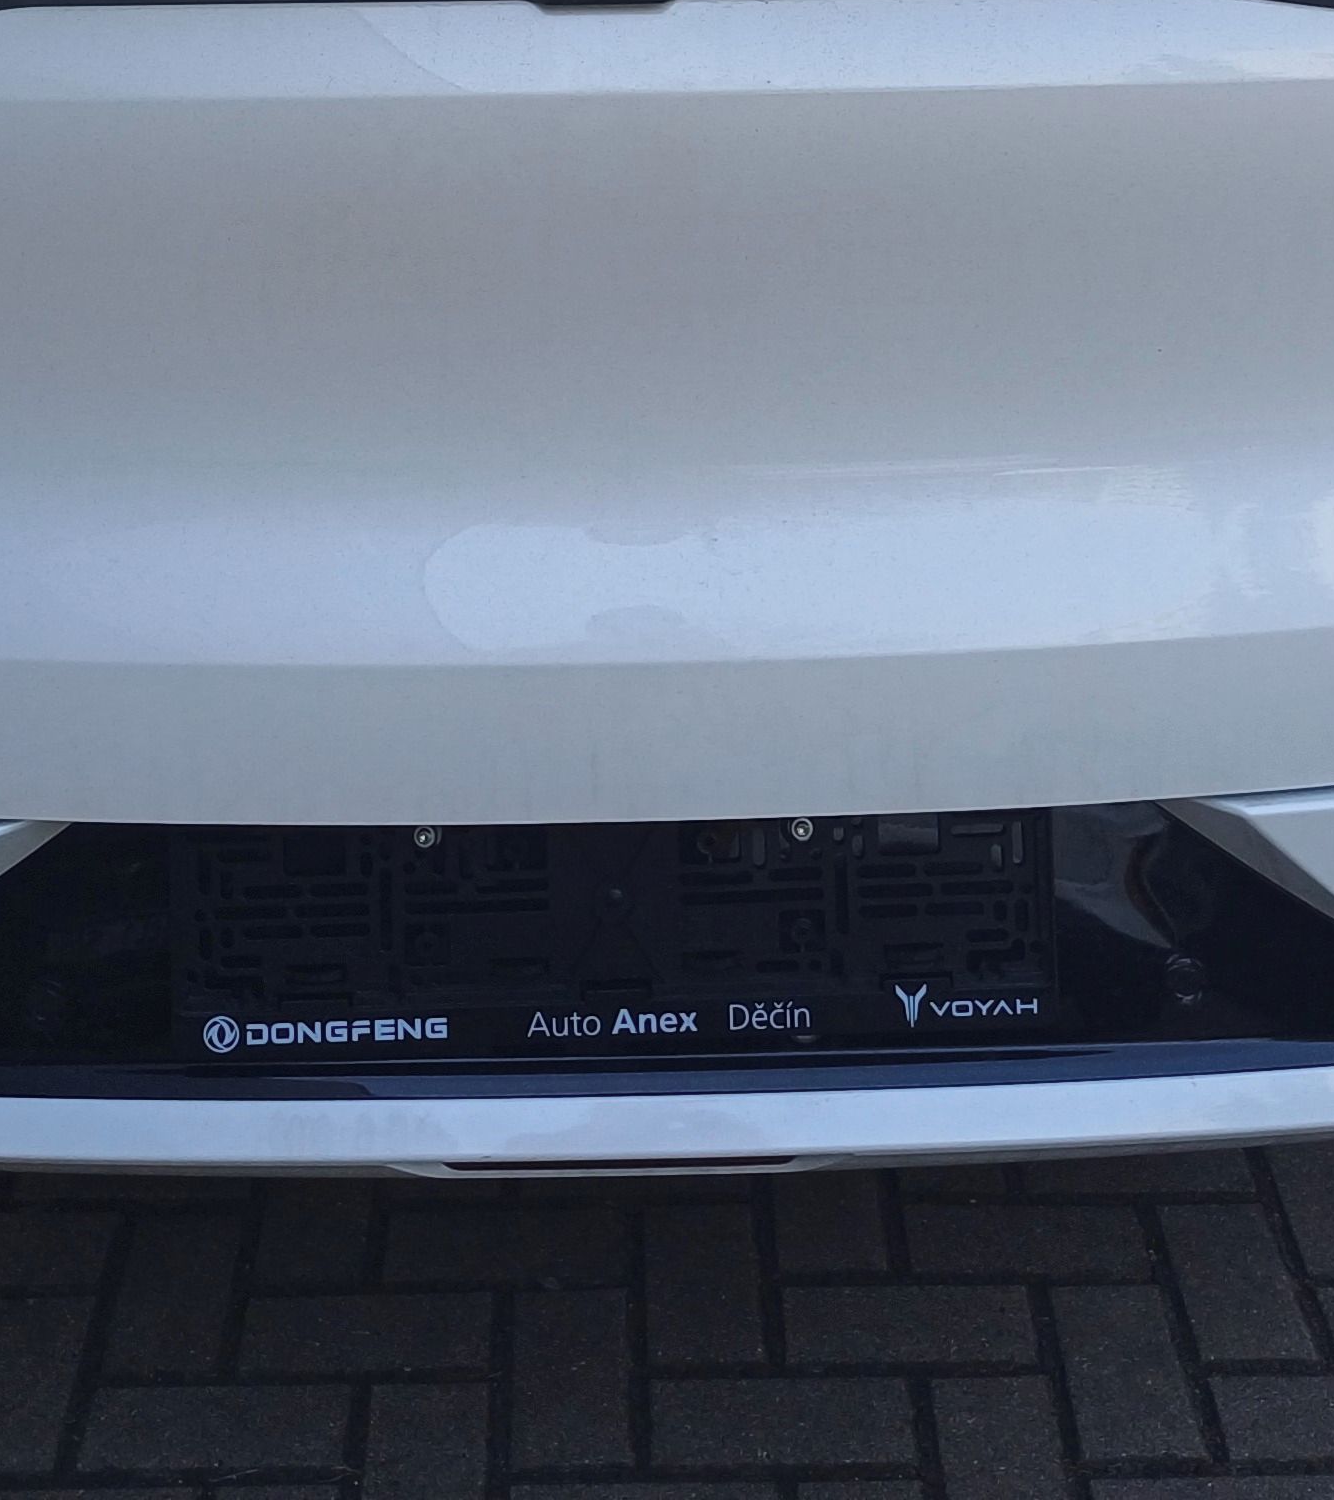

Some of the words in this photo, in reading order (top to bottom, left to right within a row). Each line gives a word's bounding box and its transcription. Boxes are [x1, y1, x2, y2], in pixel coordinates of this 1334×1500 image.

[526, 1011, 603, 1039] Auto
[611, 1007, 699, 1035] Anex
[728, 999, 812, 1031] Děčín
[929, 997, 1039, 1017] VOYAH
[245, 1016, 449, 1047] DONGFENG
